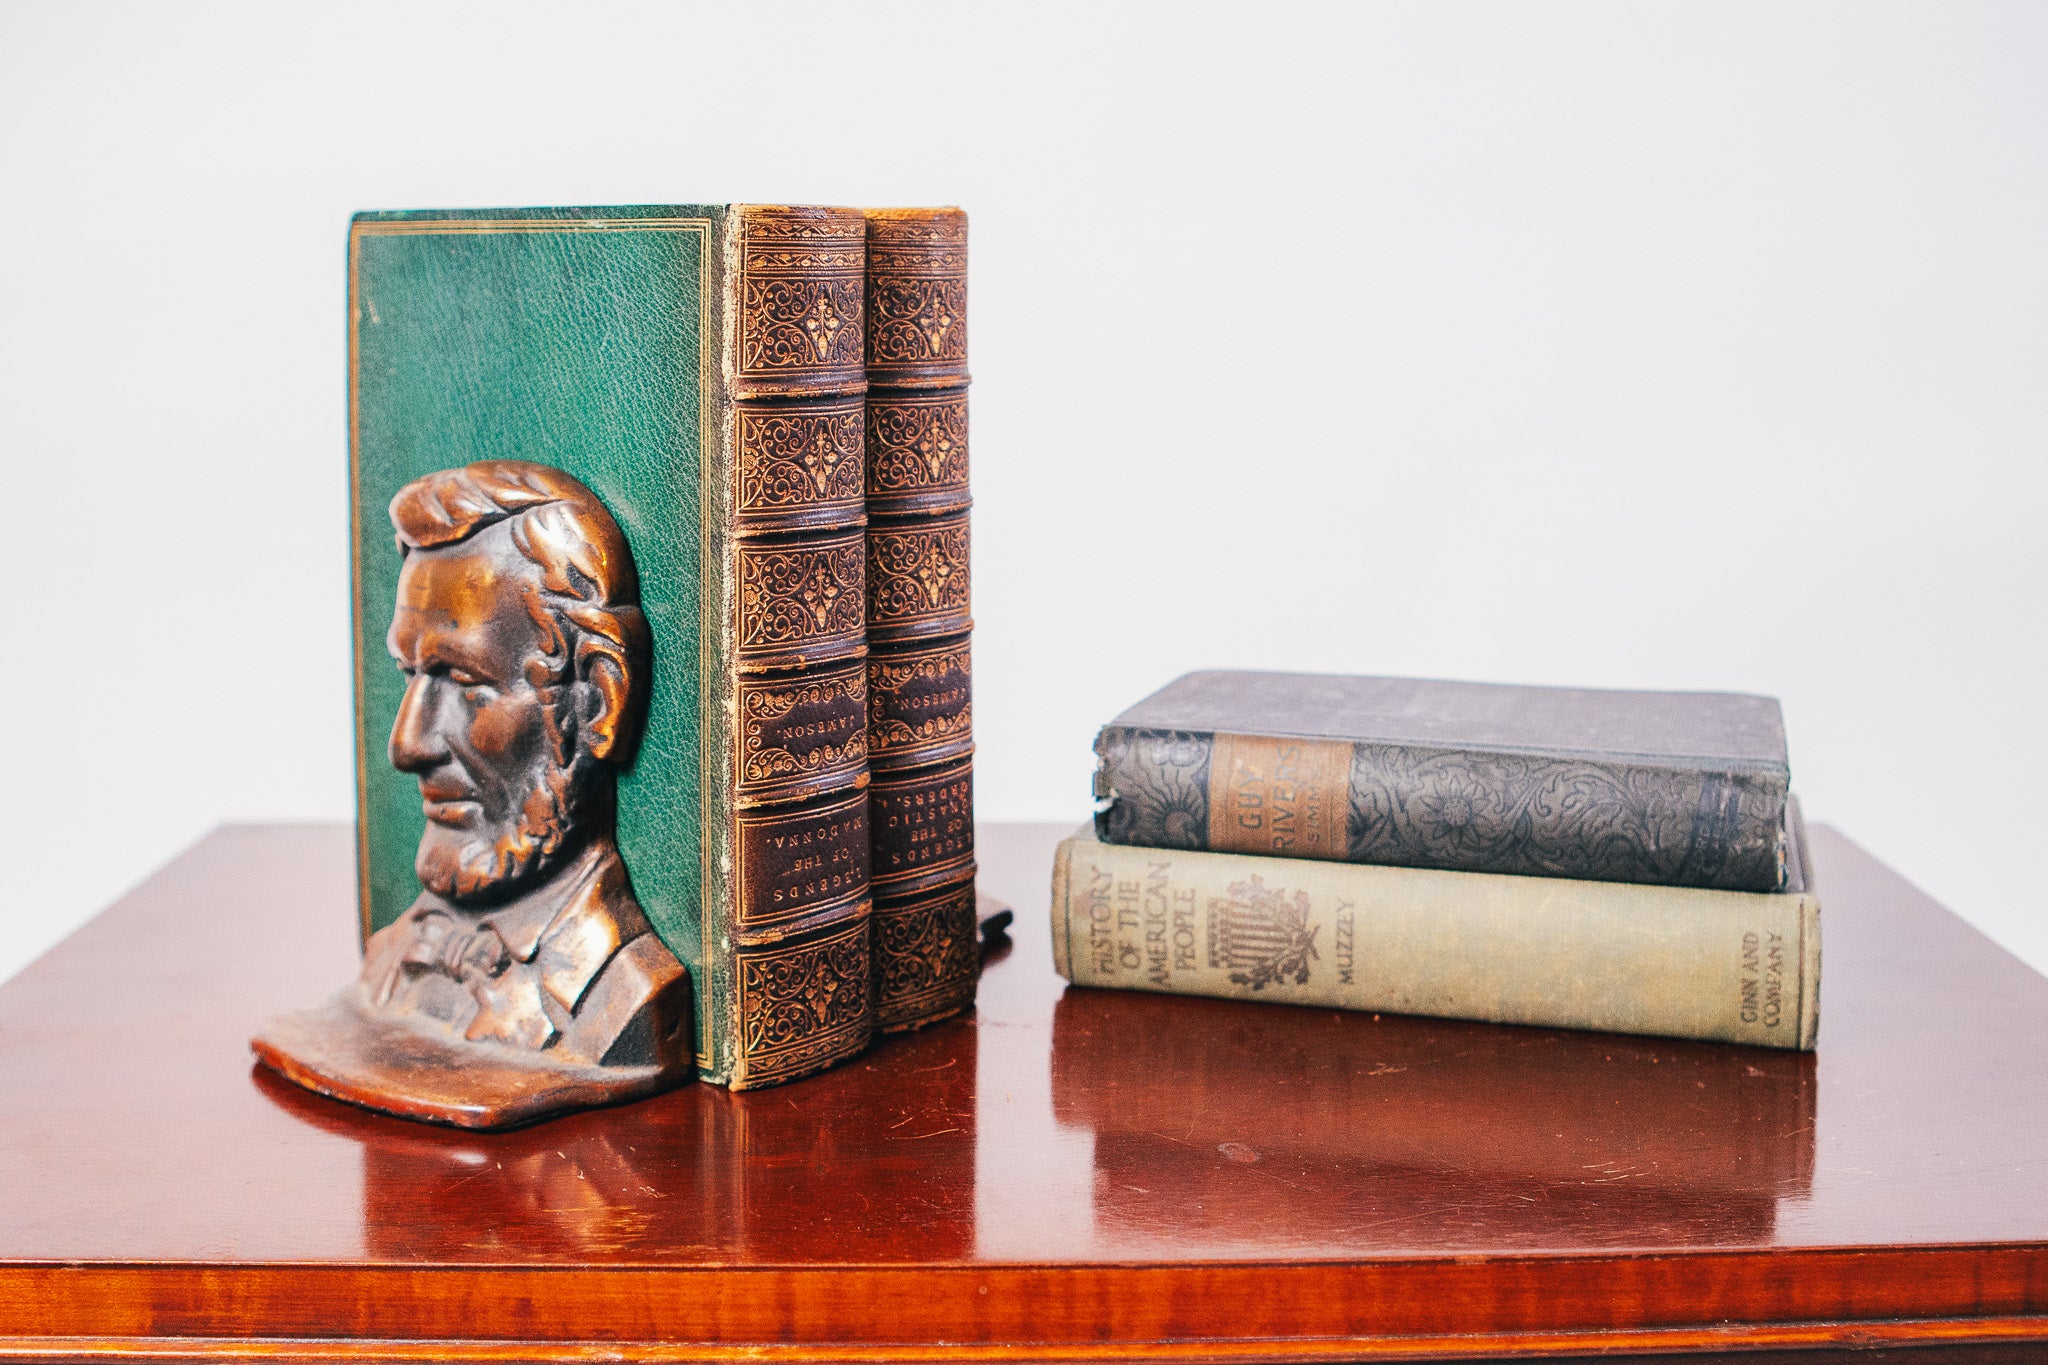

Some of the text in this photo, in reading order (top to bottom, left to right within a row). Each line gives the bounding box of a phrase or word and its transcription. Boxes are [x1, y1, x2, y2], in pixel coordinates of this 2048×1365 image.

[777, 714, 855, 740] JAMESON.
[766, 816, 862, 849] MADONNA.
[911, 827, 938, 843] THE
[1238, 766, 1264, 830] GUY
[1272, 745, 1299, 851] RIVERS
[773, 867, 862, 902] LEGENDS
[794, 847, 850, 873] OF THE
[1089, 864, 1115, 977] HISTORY
[1117, 881, 1142, 971] OF THE
[1144, 860, 1171, 988] AMERICAN
[1173, 888, 1196, 972] PEOPLE
[1335, 897, 1354, 985] MUZZEY
[1740, 931, 1760, 1024] GINN AND
[1763, 931, 1783, 1029] COMPANY
